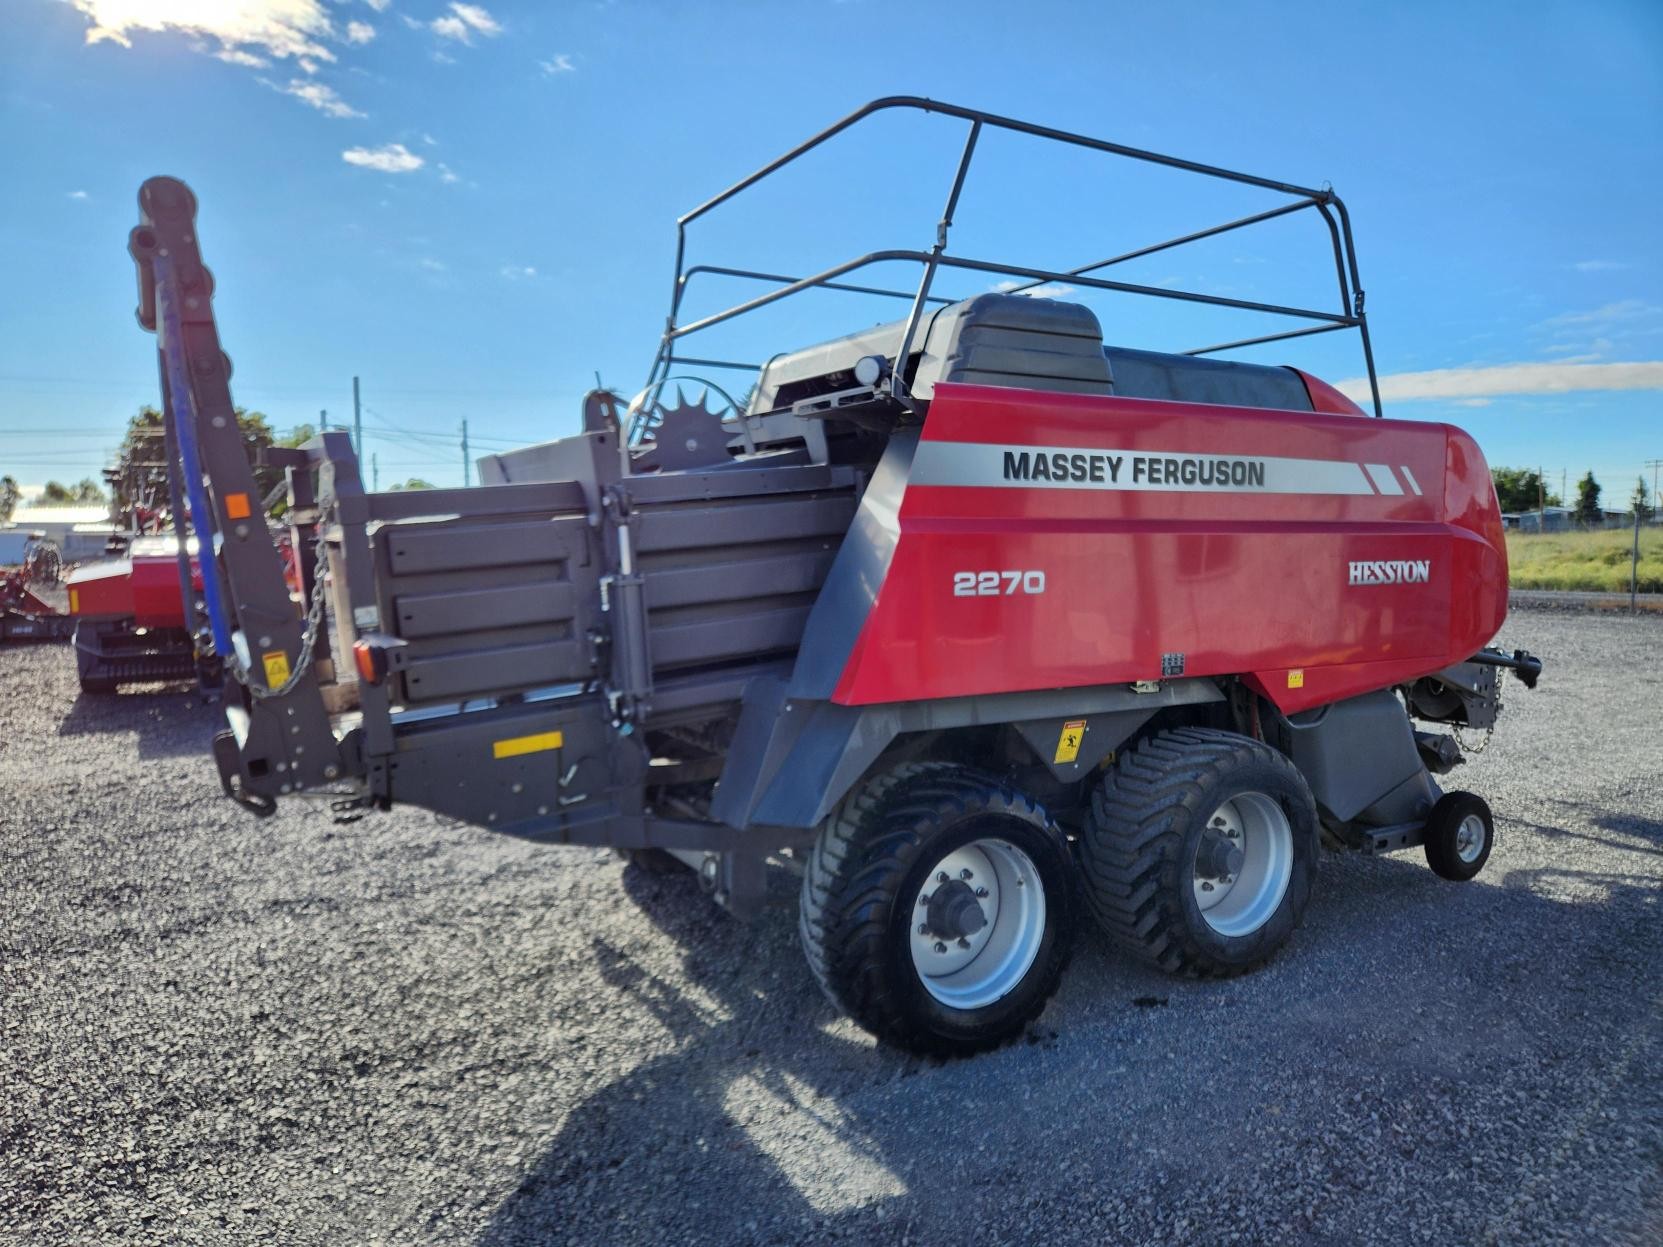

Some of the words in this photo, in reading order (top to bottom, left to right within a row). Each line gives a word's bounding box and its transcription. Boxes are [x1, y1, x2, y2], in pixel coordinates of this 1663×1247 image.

[1003, 451, 1123, 482] MASSEY
[1132, 457, 1265, 487] FERGUSON
[953, 570, 1045, 597] 2270
[1348, 559, 1431, 586] HESSTON
